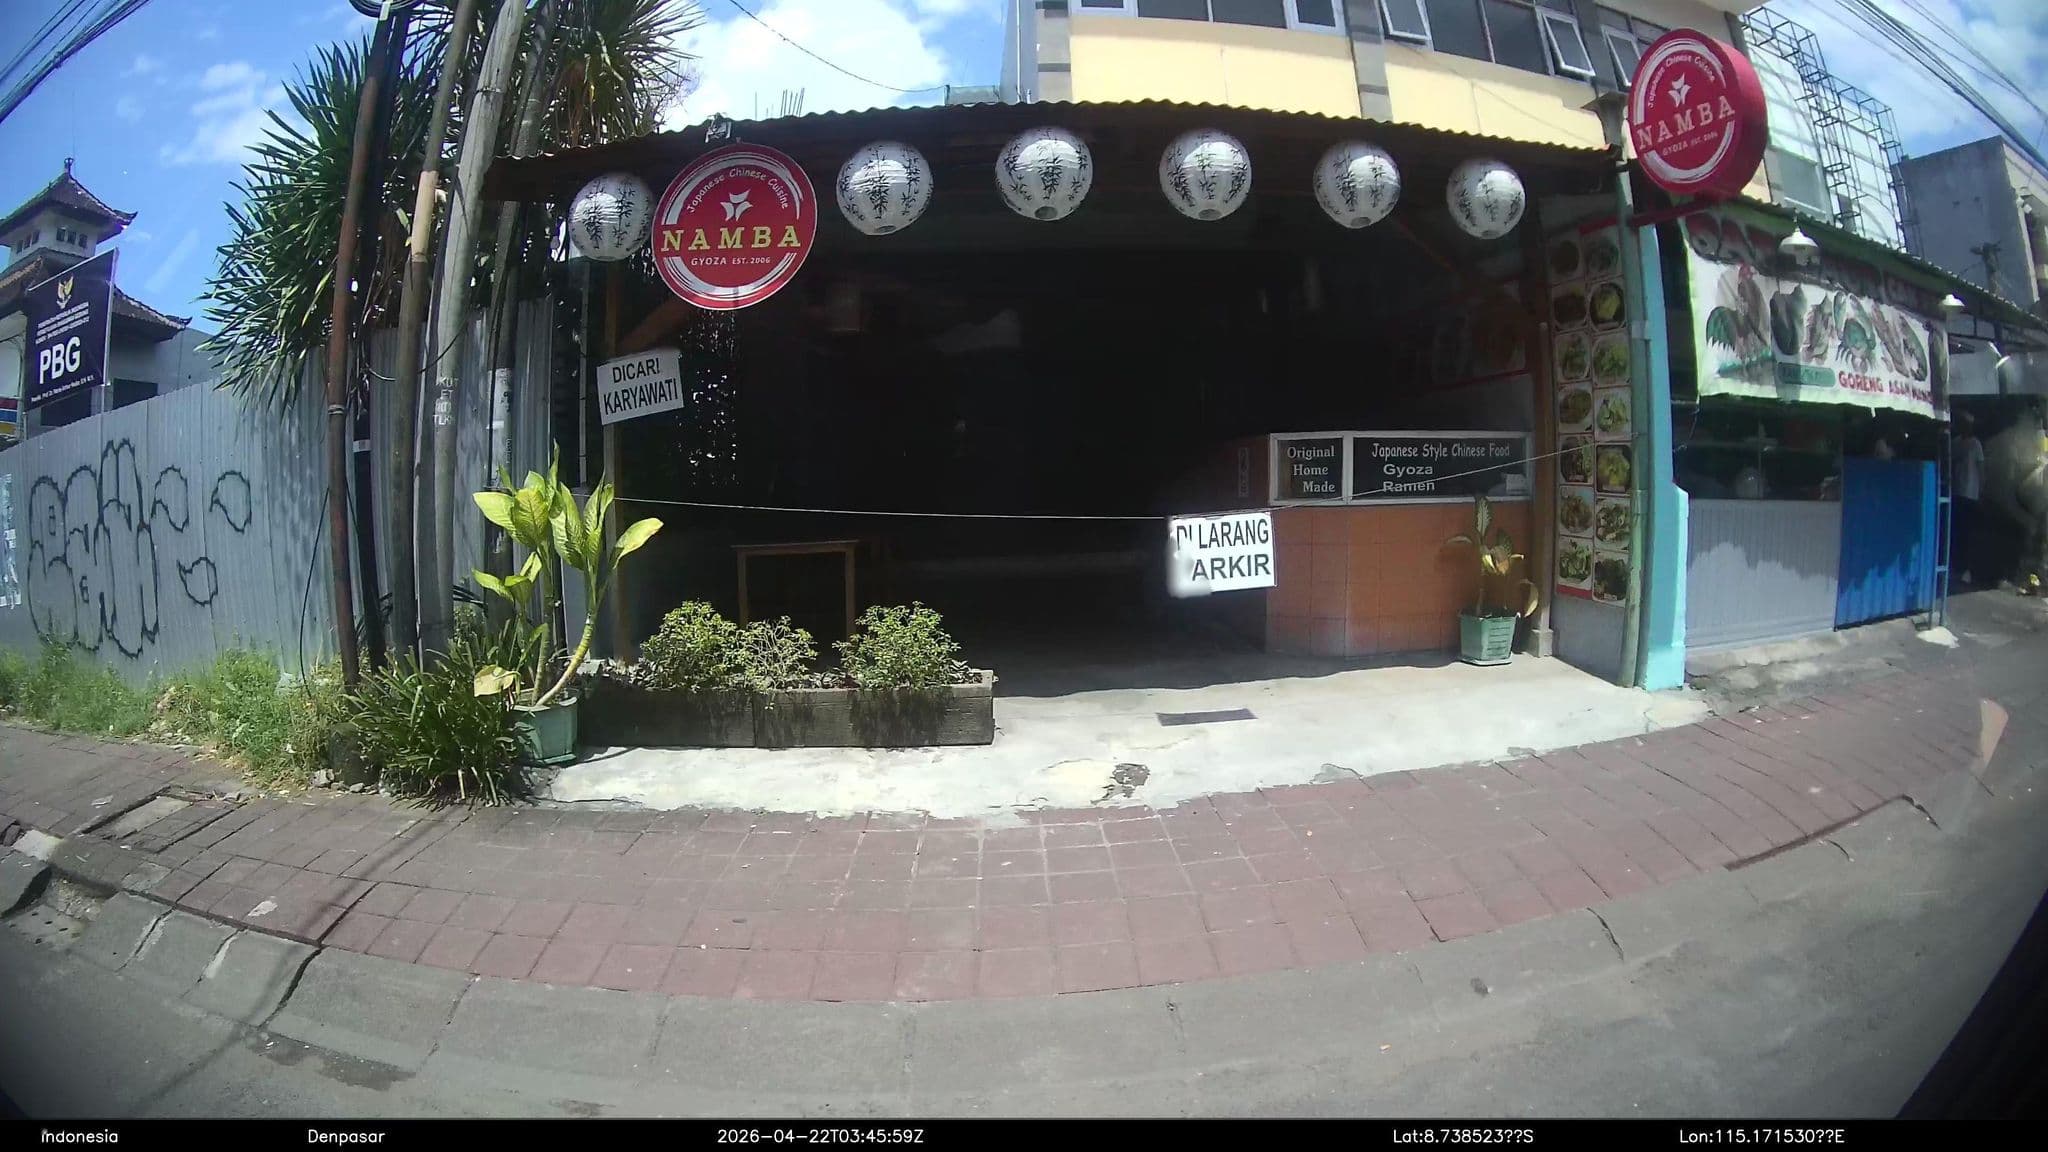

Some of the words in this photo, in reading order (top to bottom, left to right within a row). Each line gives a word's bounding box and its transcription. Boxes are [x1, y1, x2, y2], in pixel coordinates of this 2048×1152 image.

[1665, 55, 1692, 68] Chinese
[1636, 95, 1735, 150] NAMBA
[1662, 140, 1689, 156] GYOZA
[687, 174, 725, 214] Japanese
[729, 167, 767, 182] Chinese
[767, 177, 789, 209] Cuisine
[661, 225, 801, 252] NAMBA
[691, 256, 727, 266] GYOZA
[750, 256, 771, 264] 2006
[39, 336, 80, 385] PBG
[612, 357, 660, 383] DICARI
[1838, 371, 1884, 392] GORENG
[603, 378, 678, 415] KARYAWATI
[1287, 445, 1335, 461] Original
[1371, 443, 1419, 461] Japanese
[1422, 443, 1448, 462] Style
[1451, 443, 1486, 457] Chinese
[1489, 443, 1510, 457] Food
[1293, 463, 1329, 476] Home
[1383, 463, 1434, 478] Gyoza
[1303, 480, 1336, 493] Made
[1383, 480, 1435, 492] Ramen
[1198, 518, 1269, 549] LARANG
[1190, 553, 1271, 581] ARKIR
